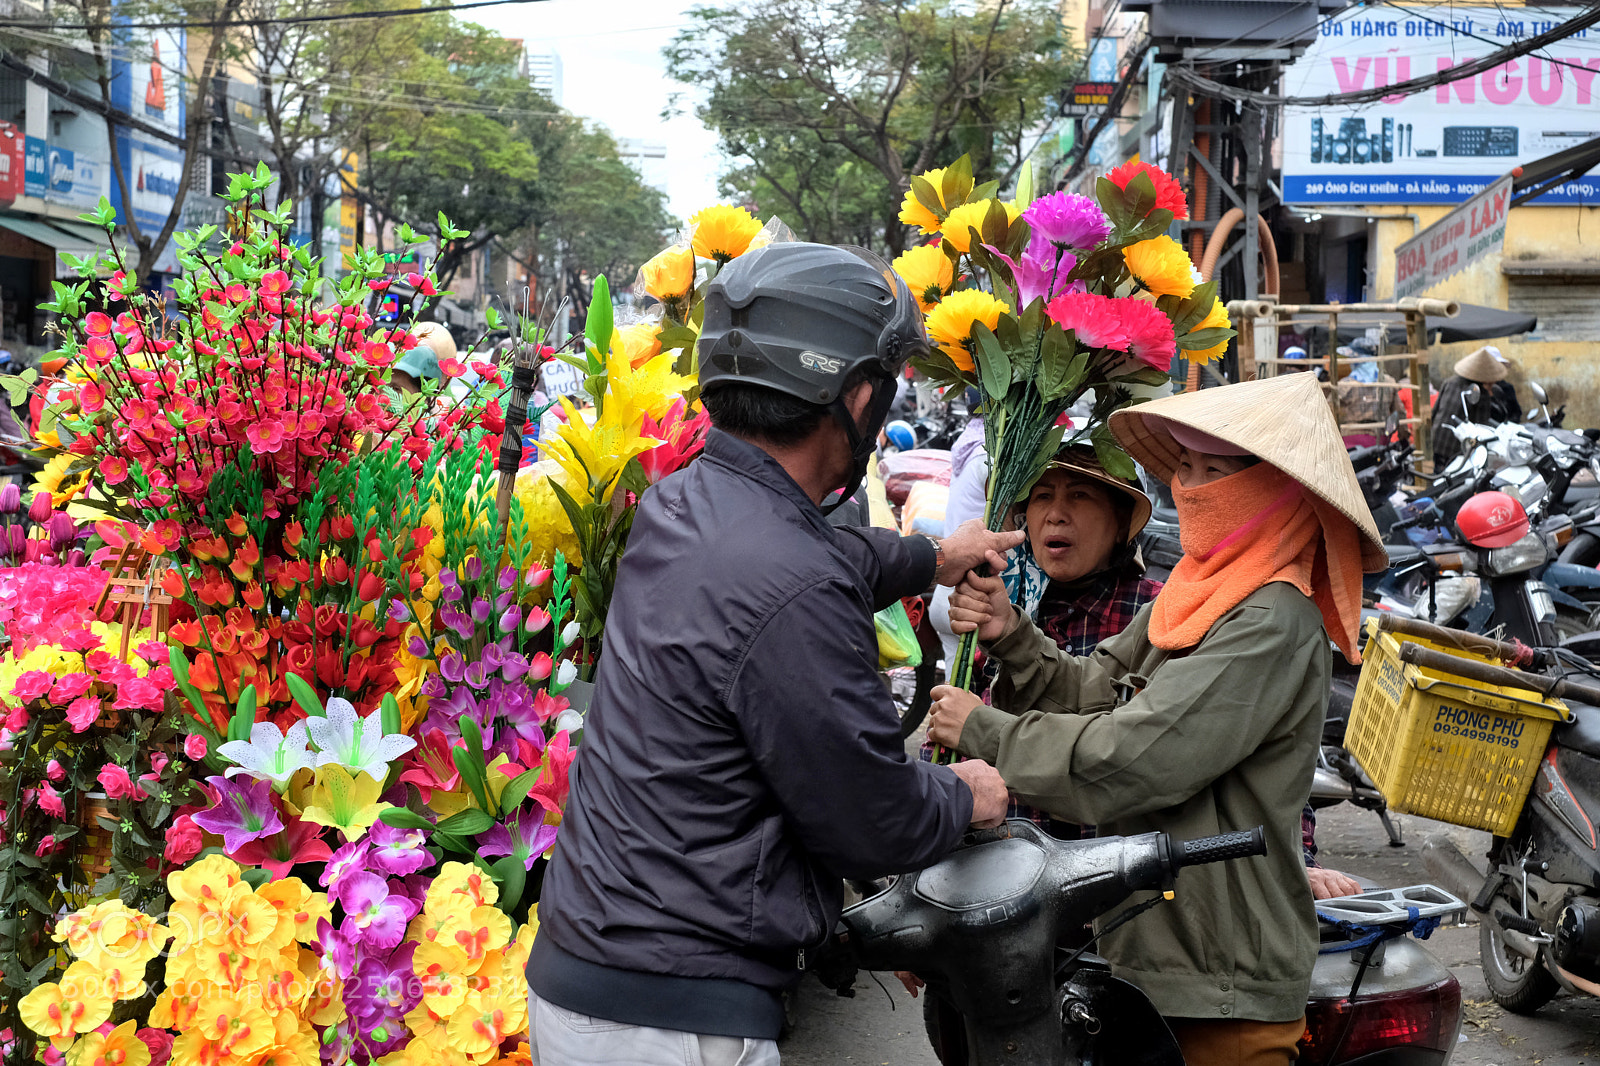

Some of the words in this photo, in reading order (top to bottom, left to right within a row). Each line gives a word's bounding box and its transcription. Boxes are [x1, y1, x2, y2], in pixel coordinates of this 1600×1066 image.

[1321, 14, 1344, 37] ỬA
[1351, 17, 1398, 37] HÀNG
[1330, 48, 1411, 104] VŨ
[1306, 183, 1324, 194] 269
[1325, 181, 1348, 194] ÔNG
[1349, 181, 1368, 194] ÍCH
[1406, 181, 1421, 194] ĐÀ
[1469, 187, 1508, 239] LAN
[800, 352, 841, 373] GRS
[1436, 705, 1490, 730] PHONG
[1492, 717, 1525, 738] PHÚ
[1433, 722, 1519, 749] 0934998199
